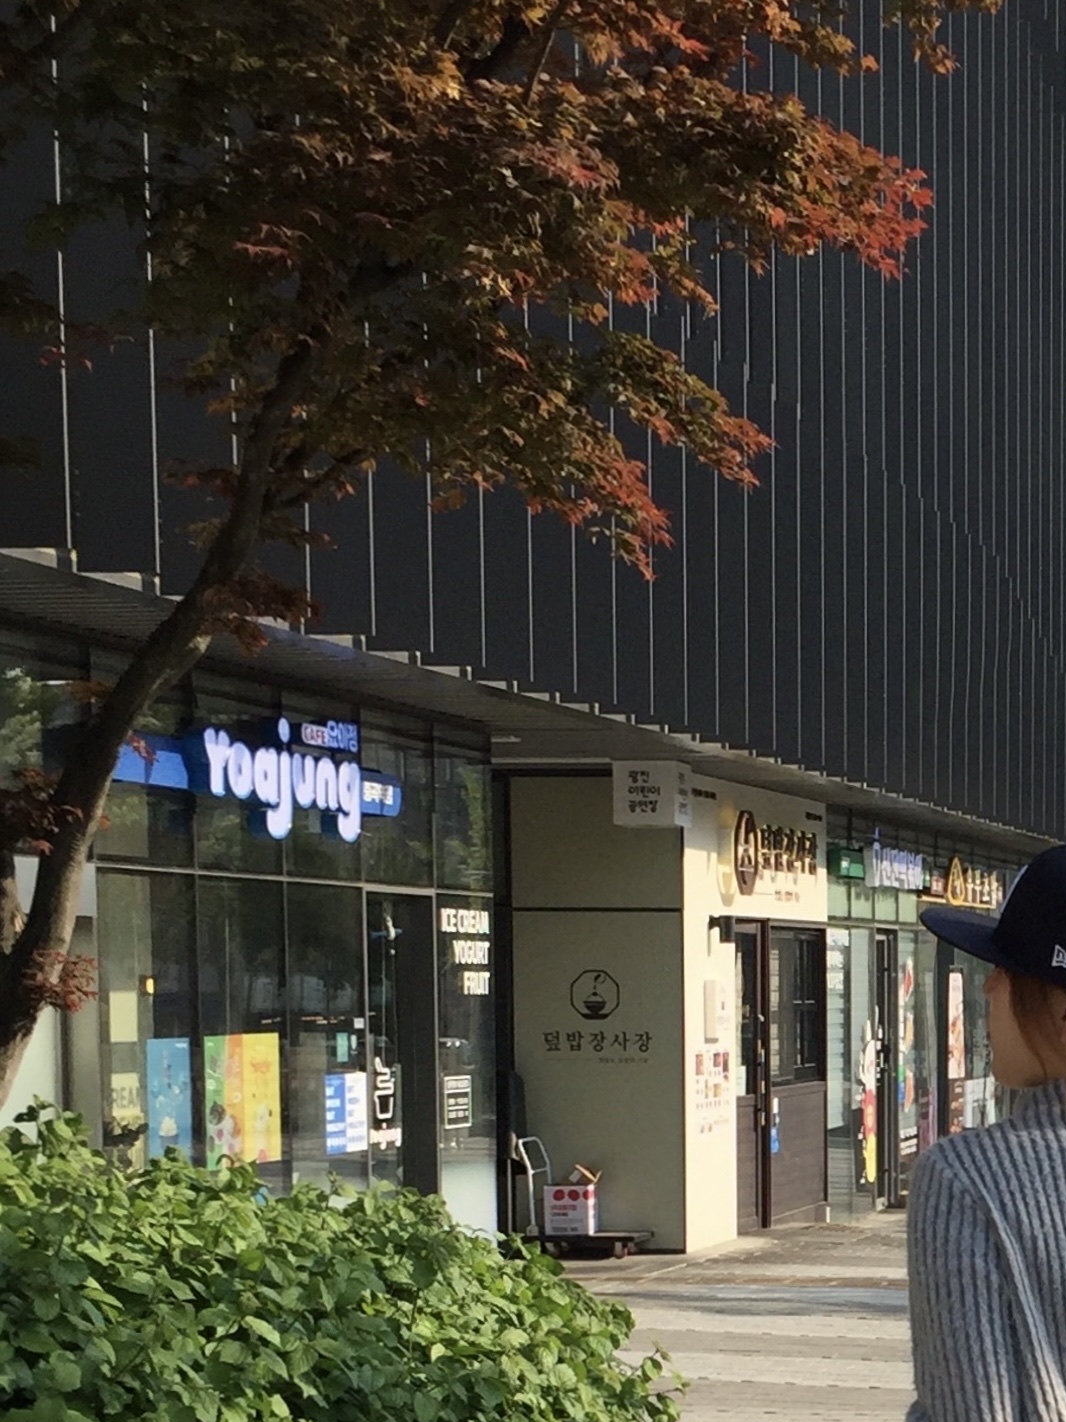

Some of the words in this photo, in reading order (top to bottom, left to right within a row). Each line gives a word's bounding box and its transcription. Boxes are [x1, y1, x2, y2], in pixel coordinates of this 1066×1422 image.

[304, 724, 328, 745] CAFE
[327, 720, 359, 754] 요아정
[204, 717, 362, 843] Yoajung
[627, 785, 661, 799] 어린이
[627, 799, 659, 814] 공연장
[758, 823, 818, 877] 덮밥장사장
[441, 907, 457, 932] ICE
[458, 908, 490, 934] CREAM
[452, 939, 490, 965] YOGURT
[463, 971, 490, 996] FRUIT
[542, 1030, 653, 1053] 덮밥장사장
